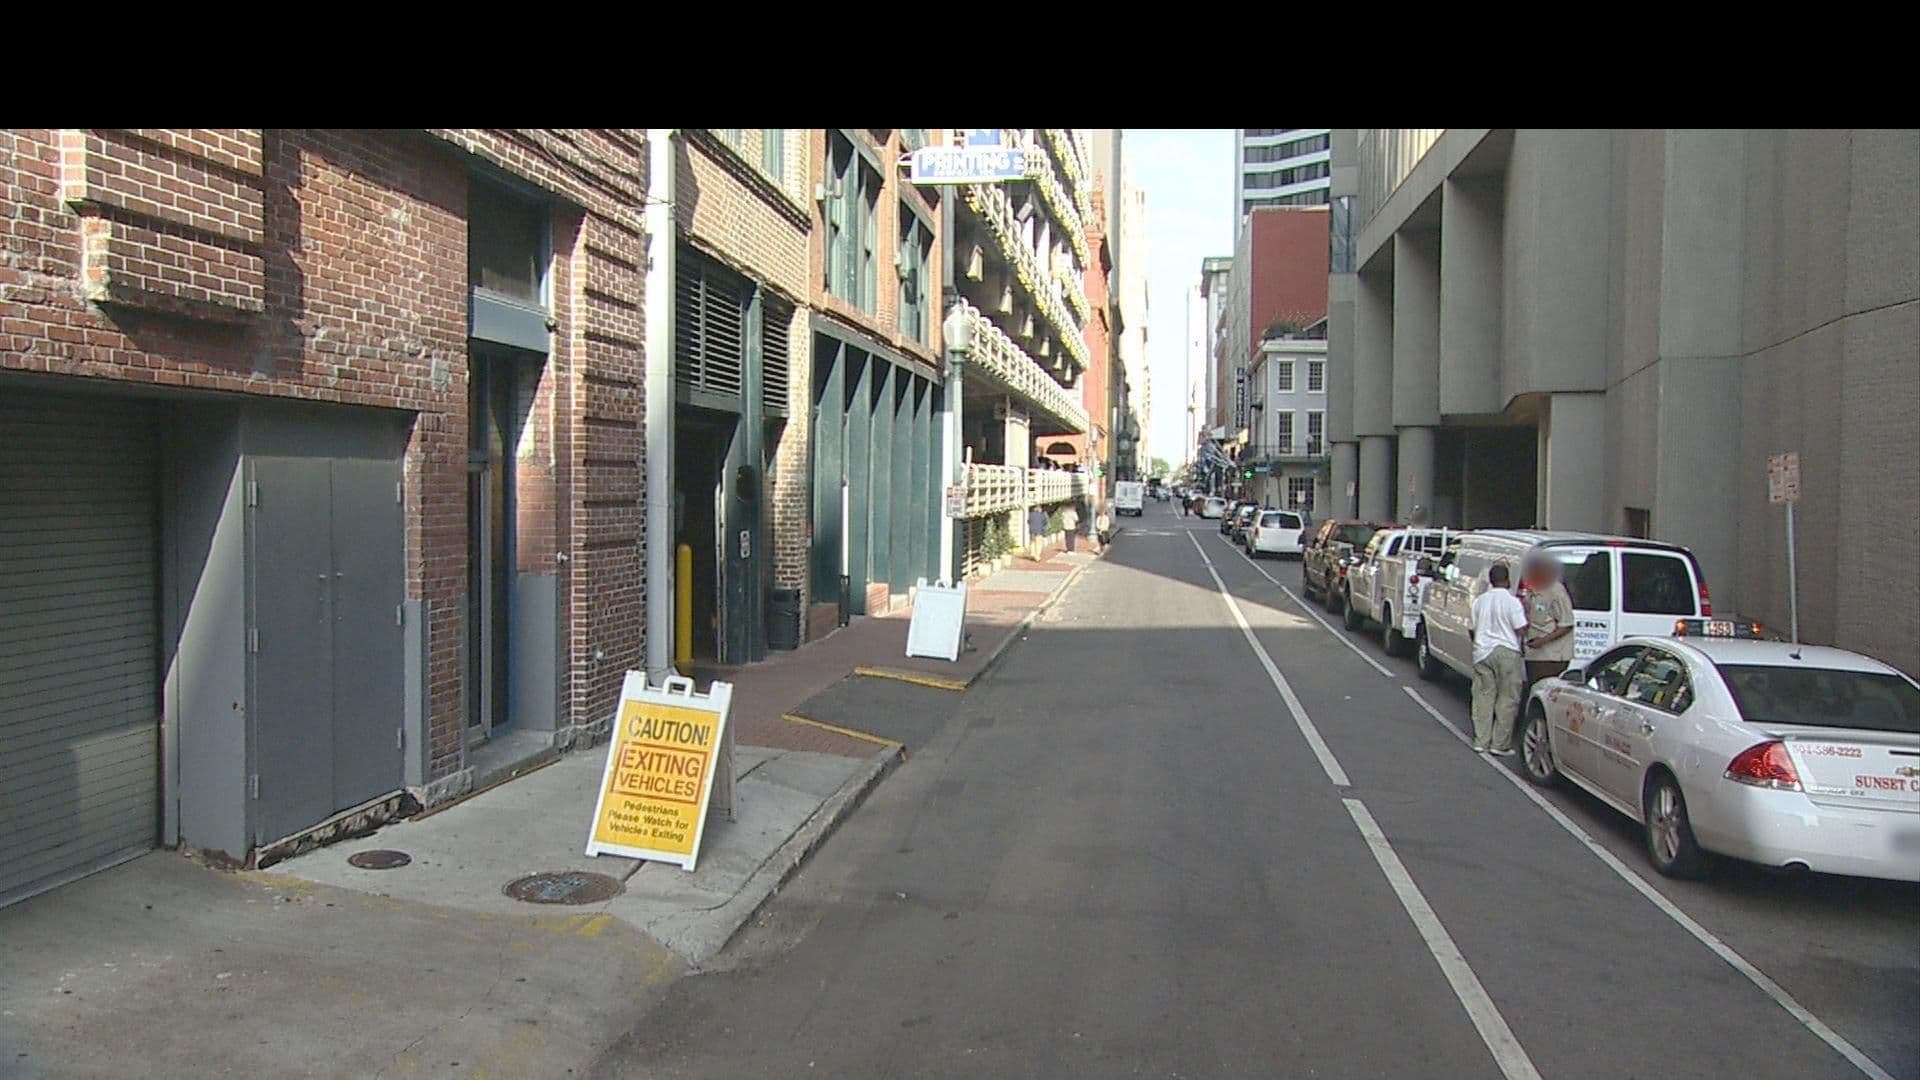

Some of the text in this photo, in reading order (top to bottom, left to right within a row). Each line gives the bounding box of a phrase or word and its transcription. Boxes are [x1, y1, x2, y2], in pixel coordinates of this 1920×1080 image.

[922, 151, 1010, 171] PRINTING
[1576, 632, 1609, 640] ACHINERY
[628, 715, 711, 746] CAUTION!
[621, 749, 701, 778] EXITING
[619, 771, 697, 797] VEHICLES
[1855, 775, 1906, 791] SUNSET
[1910, 779, 1920, 792] C
[624, 800, 679, 816] Pedestrians
[608, 809, 690, 830] Please Watch for
[609, 821, 685, 843] Vehicles Exiting
